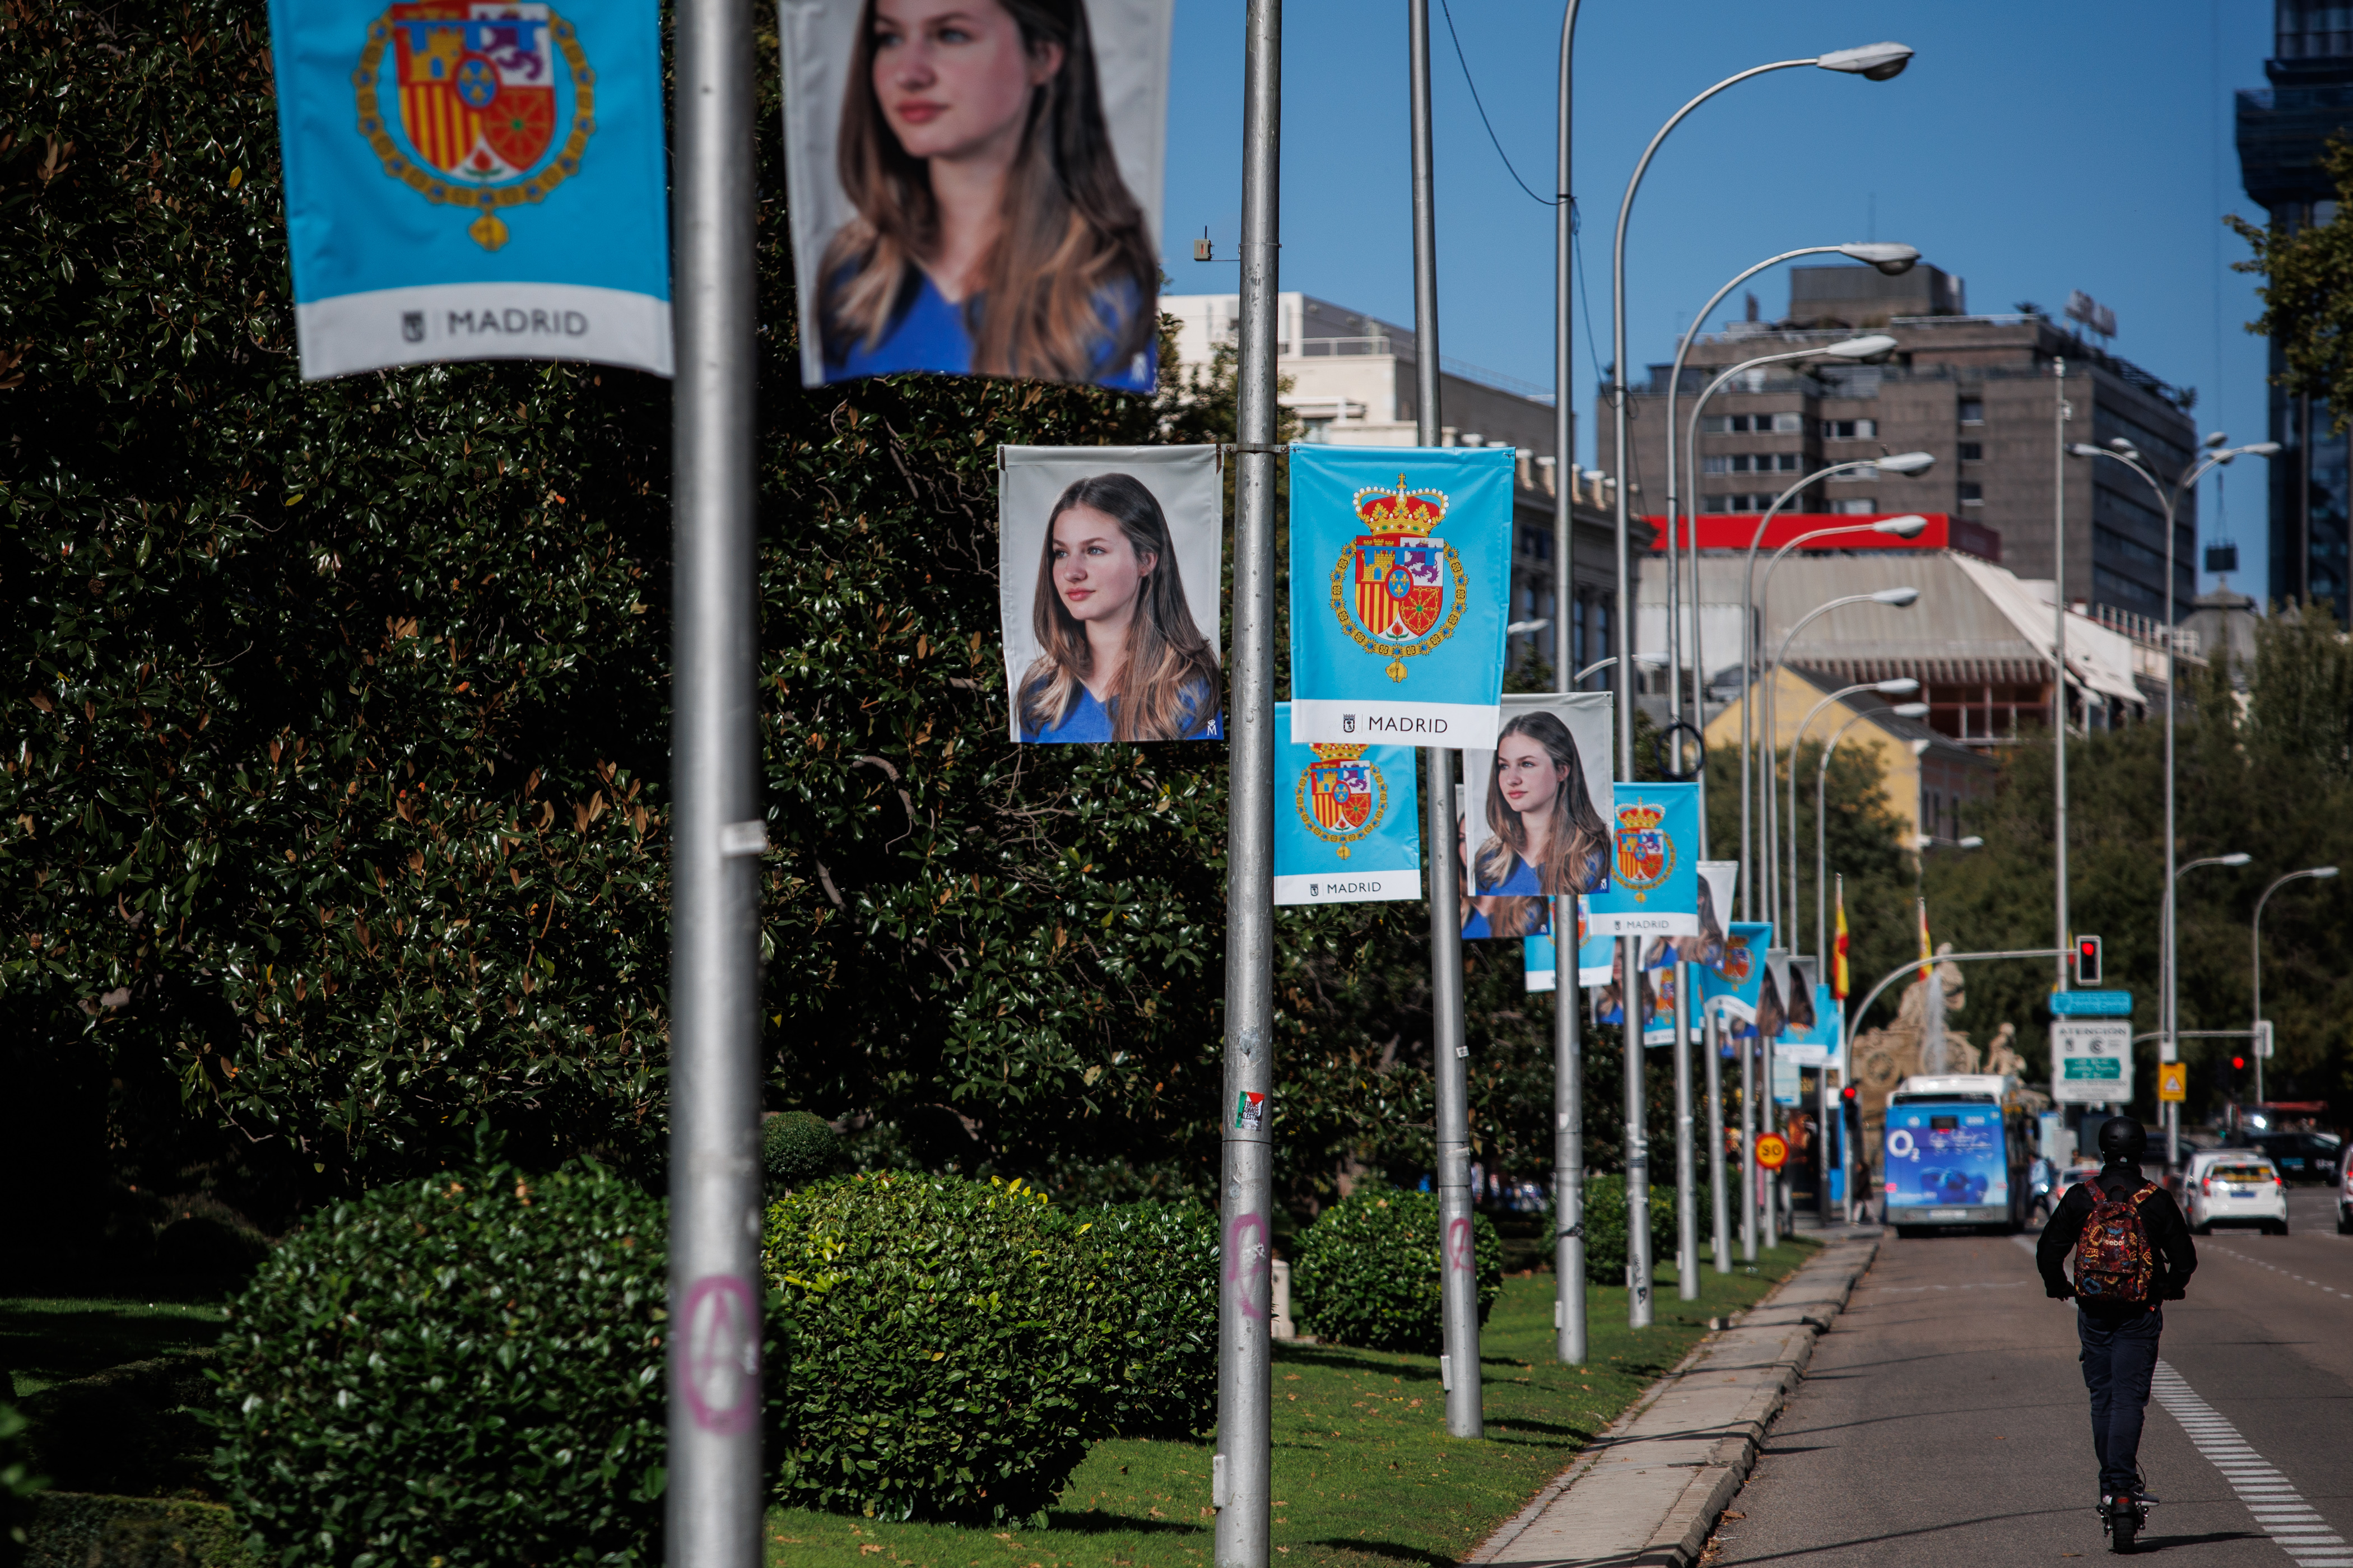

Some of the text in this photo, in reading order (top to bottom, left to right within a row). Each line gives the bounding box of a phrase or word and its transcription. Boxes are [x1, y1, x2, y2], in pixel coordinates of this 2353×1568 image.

[448, 308, 589, 336] MADRID
[1369, 716, 1448, 733] MADRID
[1327, 882, 1382, 894] MADRID
[1238, 1111, 1262, 1121] PALESTIN
[1241, 1106, 1259, 1115] SOMOS
[1761, 1144, 1782, 1156] 30
